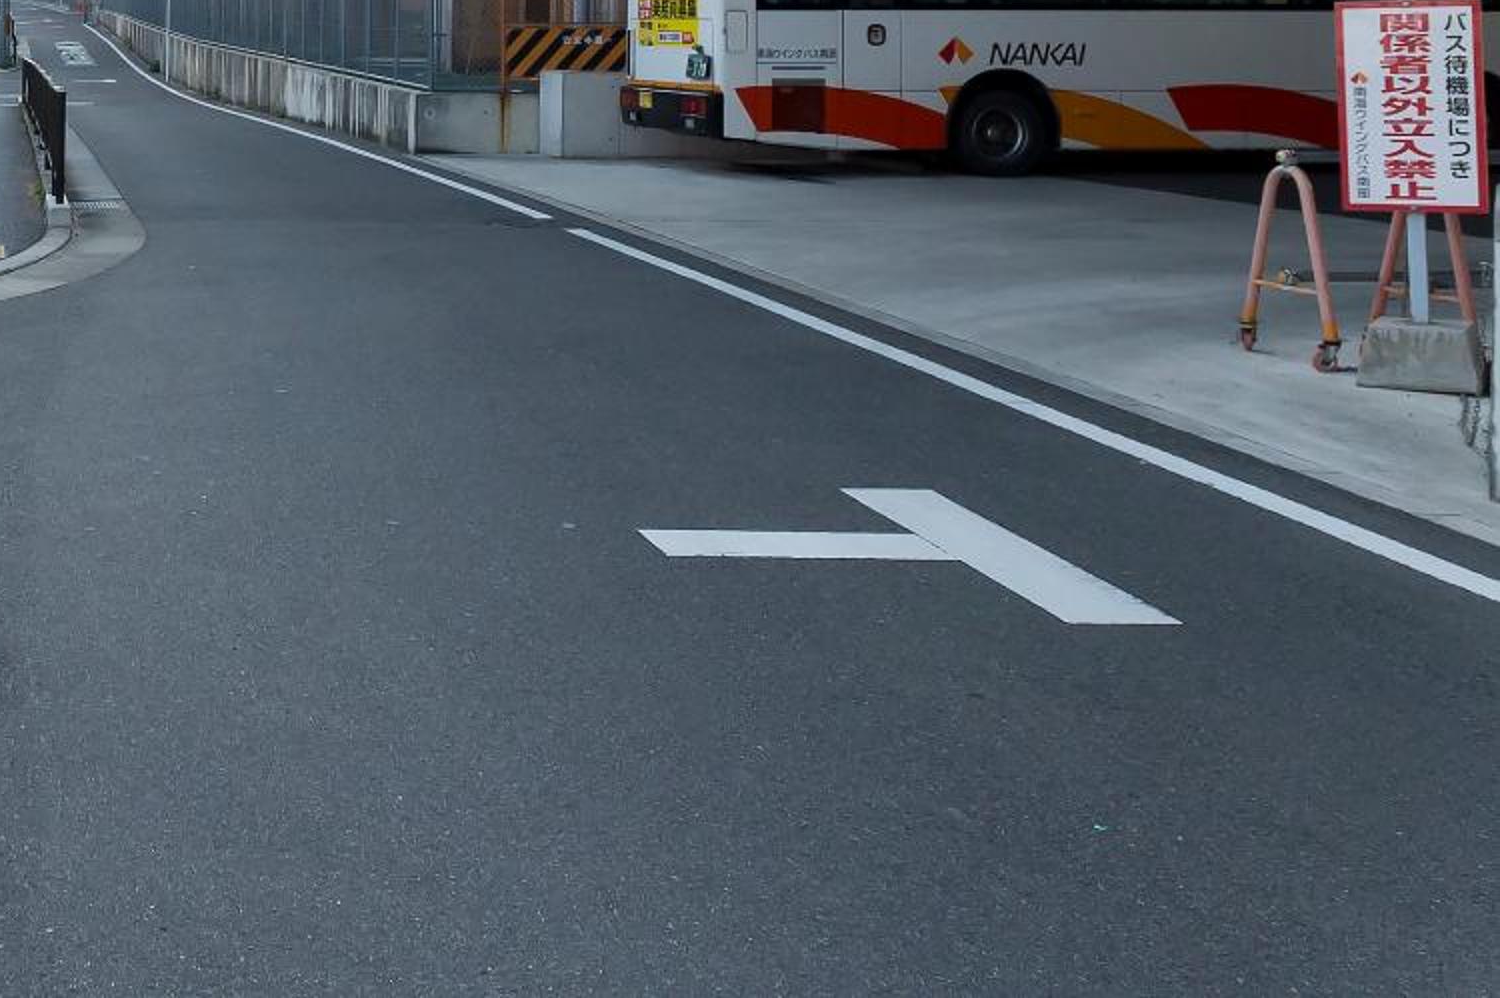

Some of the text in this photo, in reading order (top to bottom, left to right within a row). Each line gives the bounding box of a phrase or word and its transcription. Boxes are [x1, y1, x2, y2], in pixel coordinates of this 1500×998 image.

[989, 43, 1086, 66] NANKAI
[1379, 13, 1437, 201] 関係者以外立入禁止
[1444, 12, 1471, 179] バス待機場につき
